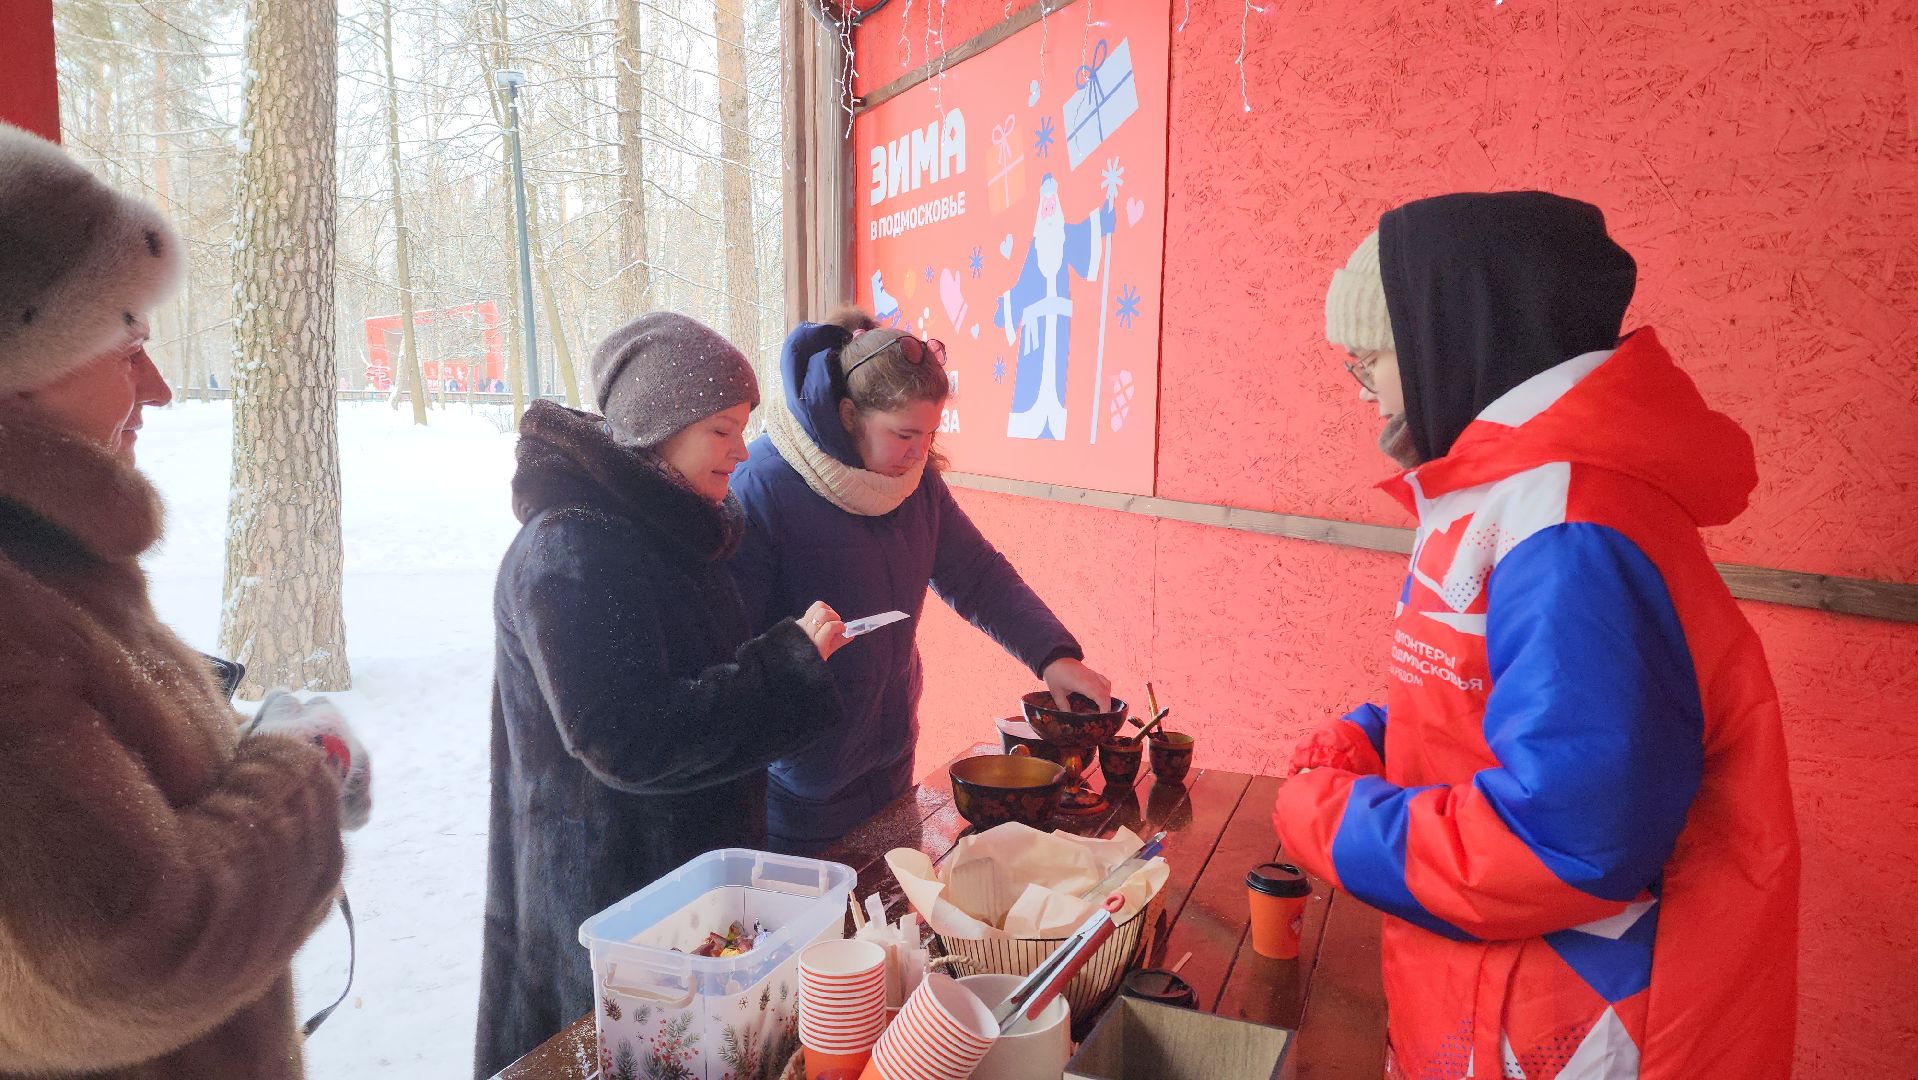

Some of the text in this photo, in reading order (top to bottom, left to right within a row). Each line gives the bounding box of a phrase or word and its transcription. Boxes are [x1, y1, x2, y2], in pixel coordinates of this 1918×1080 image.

[870, 107, 966, 207] ЗИМА
[870, 191, 966, 241] В ПОДМОСКОВЬЕ
